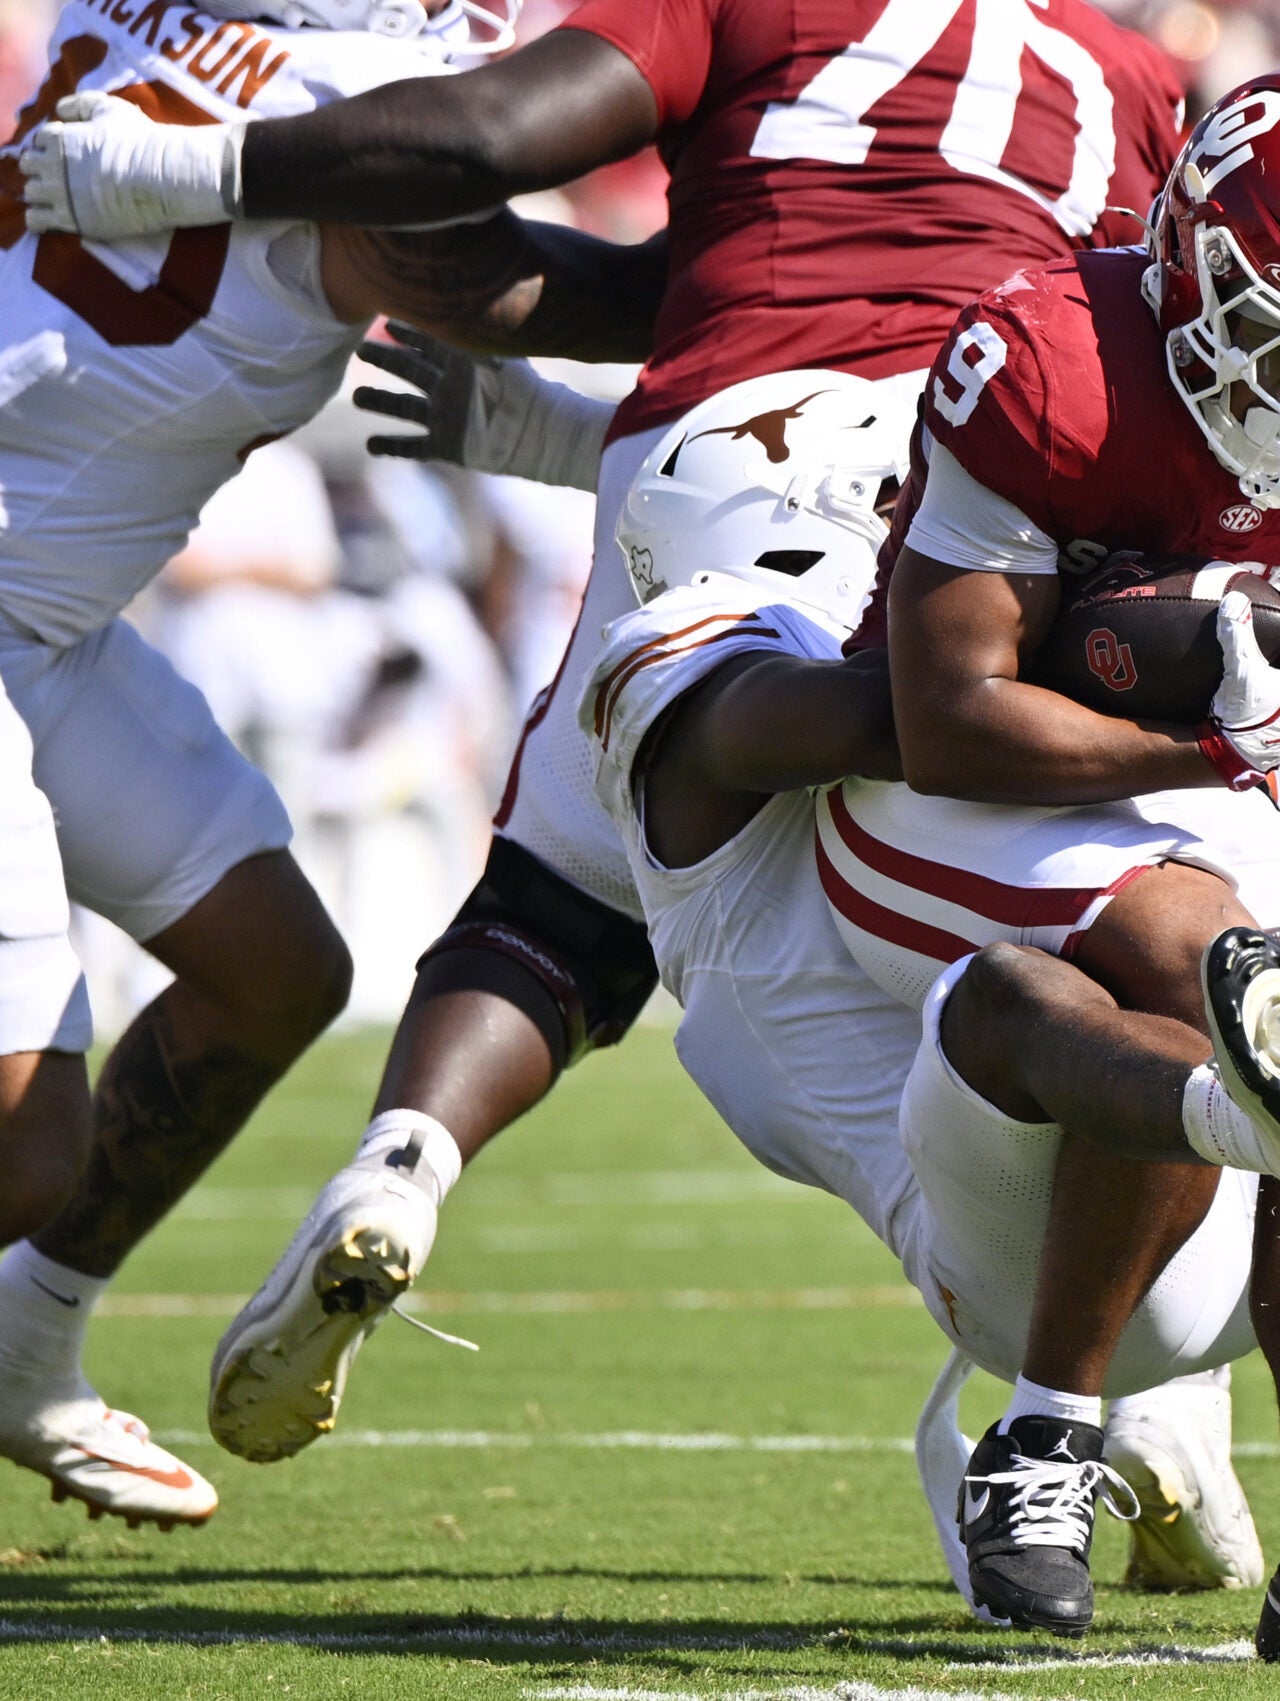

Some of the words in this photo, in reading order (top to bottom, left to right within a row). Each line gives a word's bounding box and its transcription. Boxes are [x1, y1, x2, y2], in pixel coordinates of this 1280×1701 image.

[934, 321, 1008, 428] 9
[1222, 505, 1259, 531] SEC
[1086, 628, 1138, 692] OU
